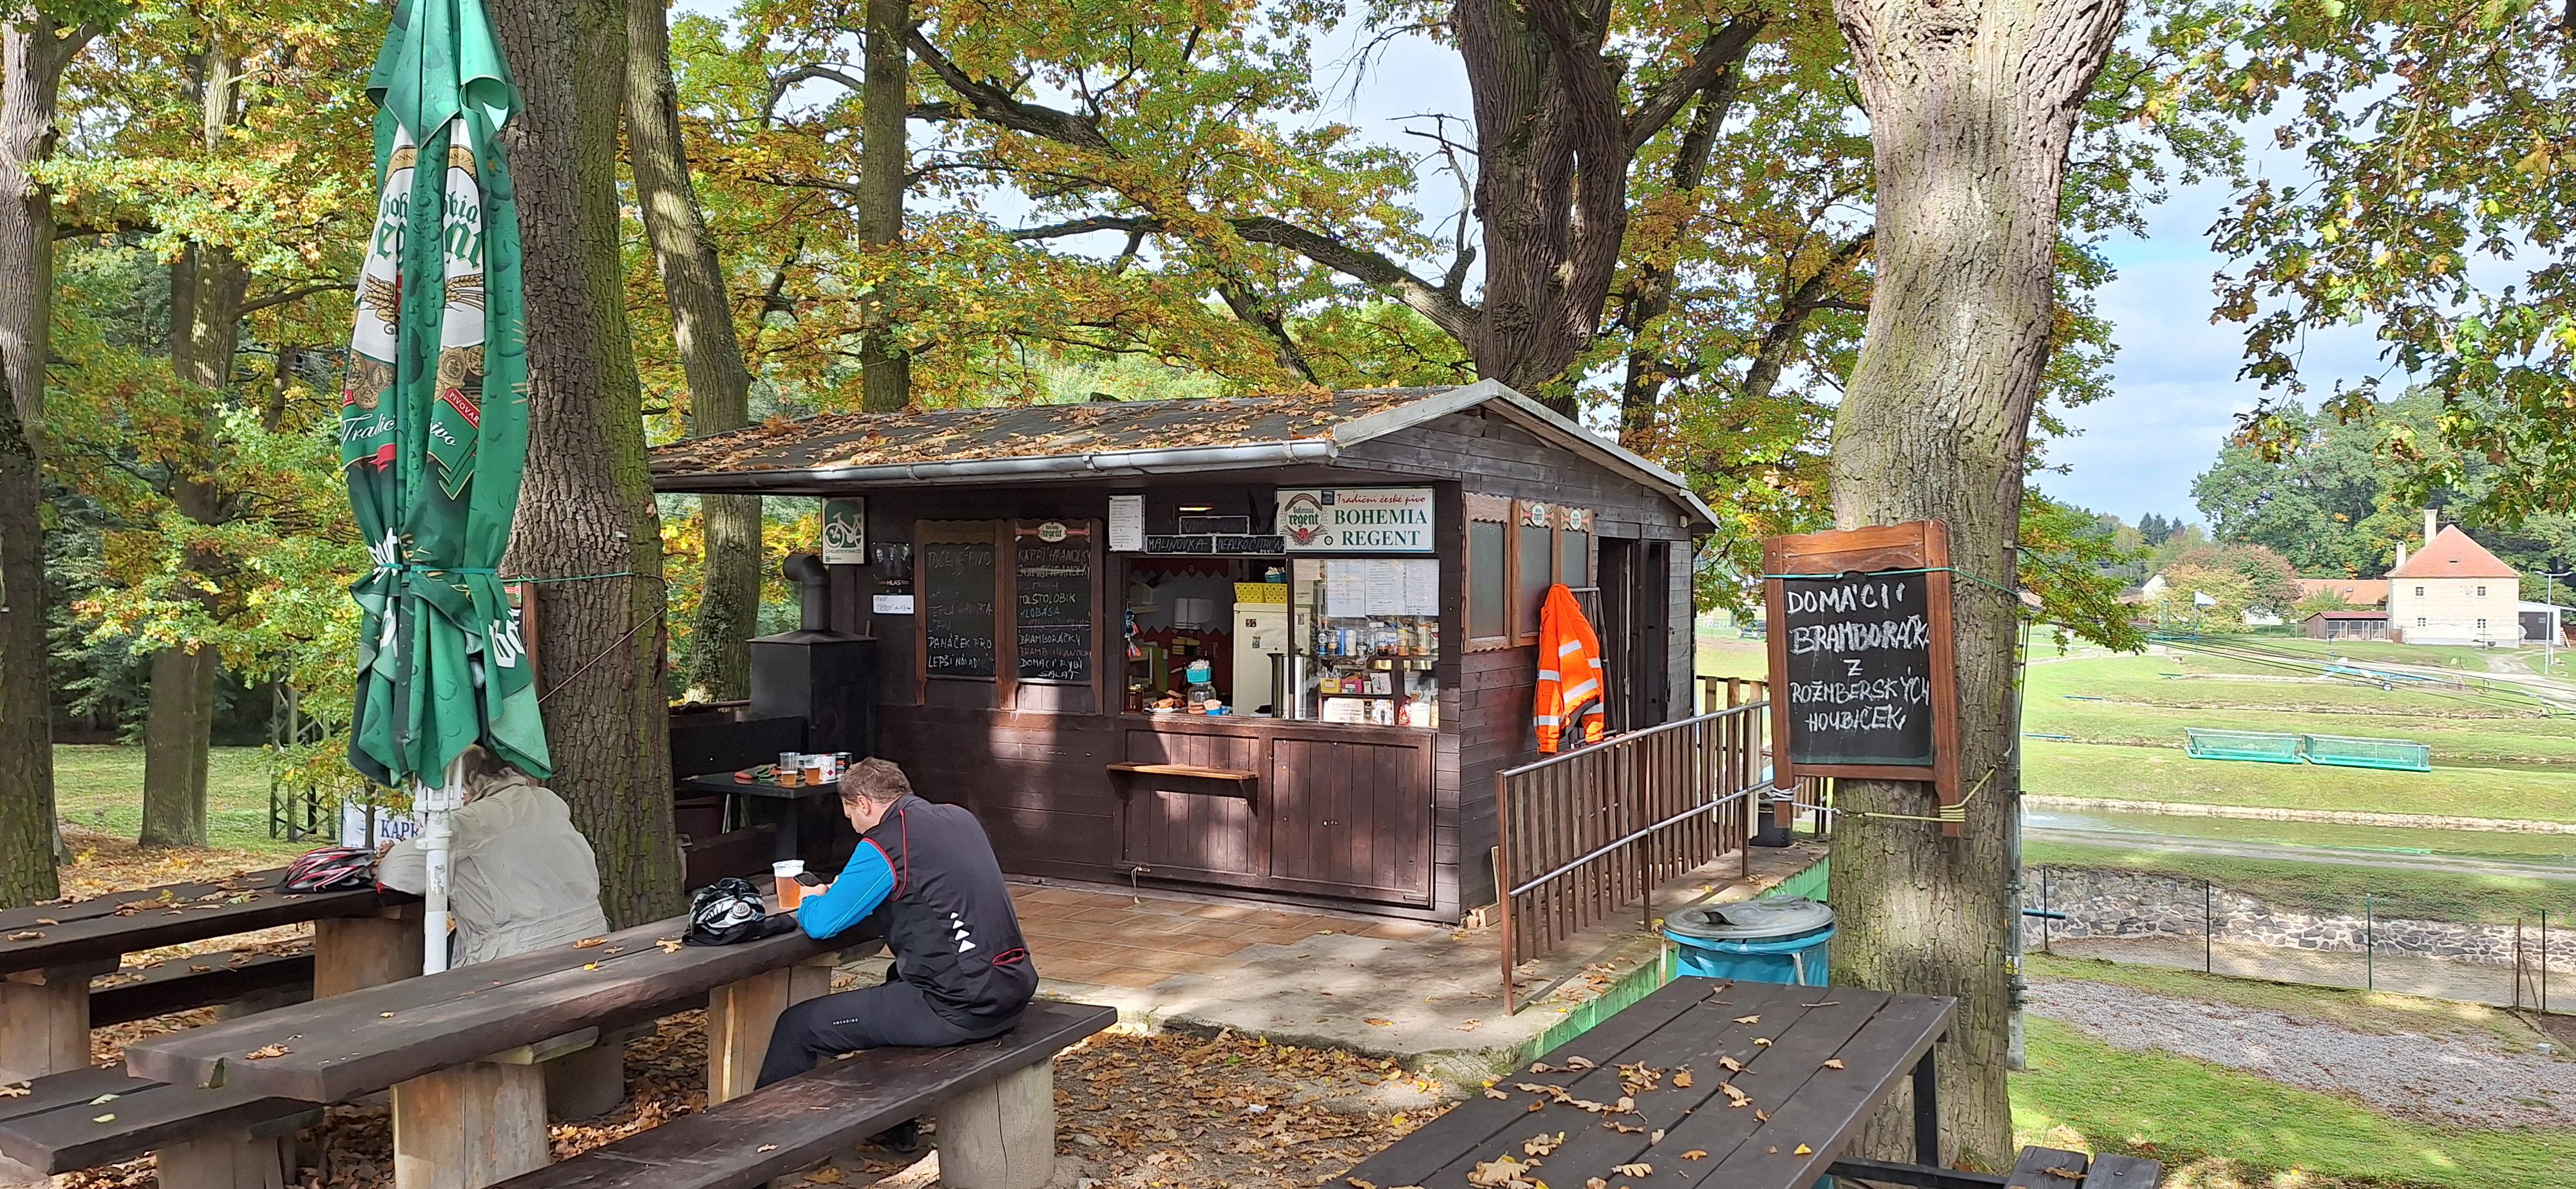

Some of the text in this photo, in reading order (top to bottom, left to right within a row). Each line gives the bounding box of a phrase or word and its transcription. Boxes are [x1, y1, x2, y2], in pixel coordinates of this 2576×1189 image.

[449, 391, 480, 424] PIVOVAR
[1336, 493, 1426, 506] Tradiční české pivo
[1289, 514, 1320, 528] regent
[1334, 509, 1428, 525] BOHEMIA
[1043, 529, 1062, 539] regent
[1341, 530, 1421, 546] REGENT
[973, 637, 992, 649] PRO
[1843, 659, 1864, 676] Z
